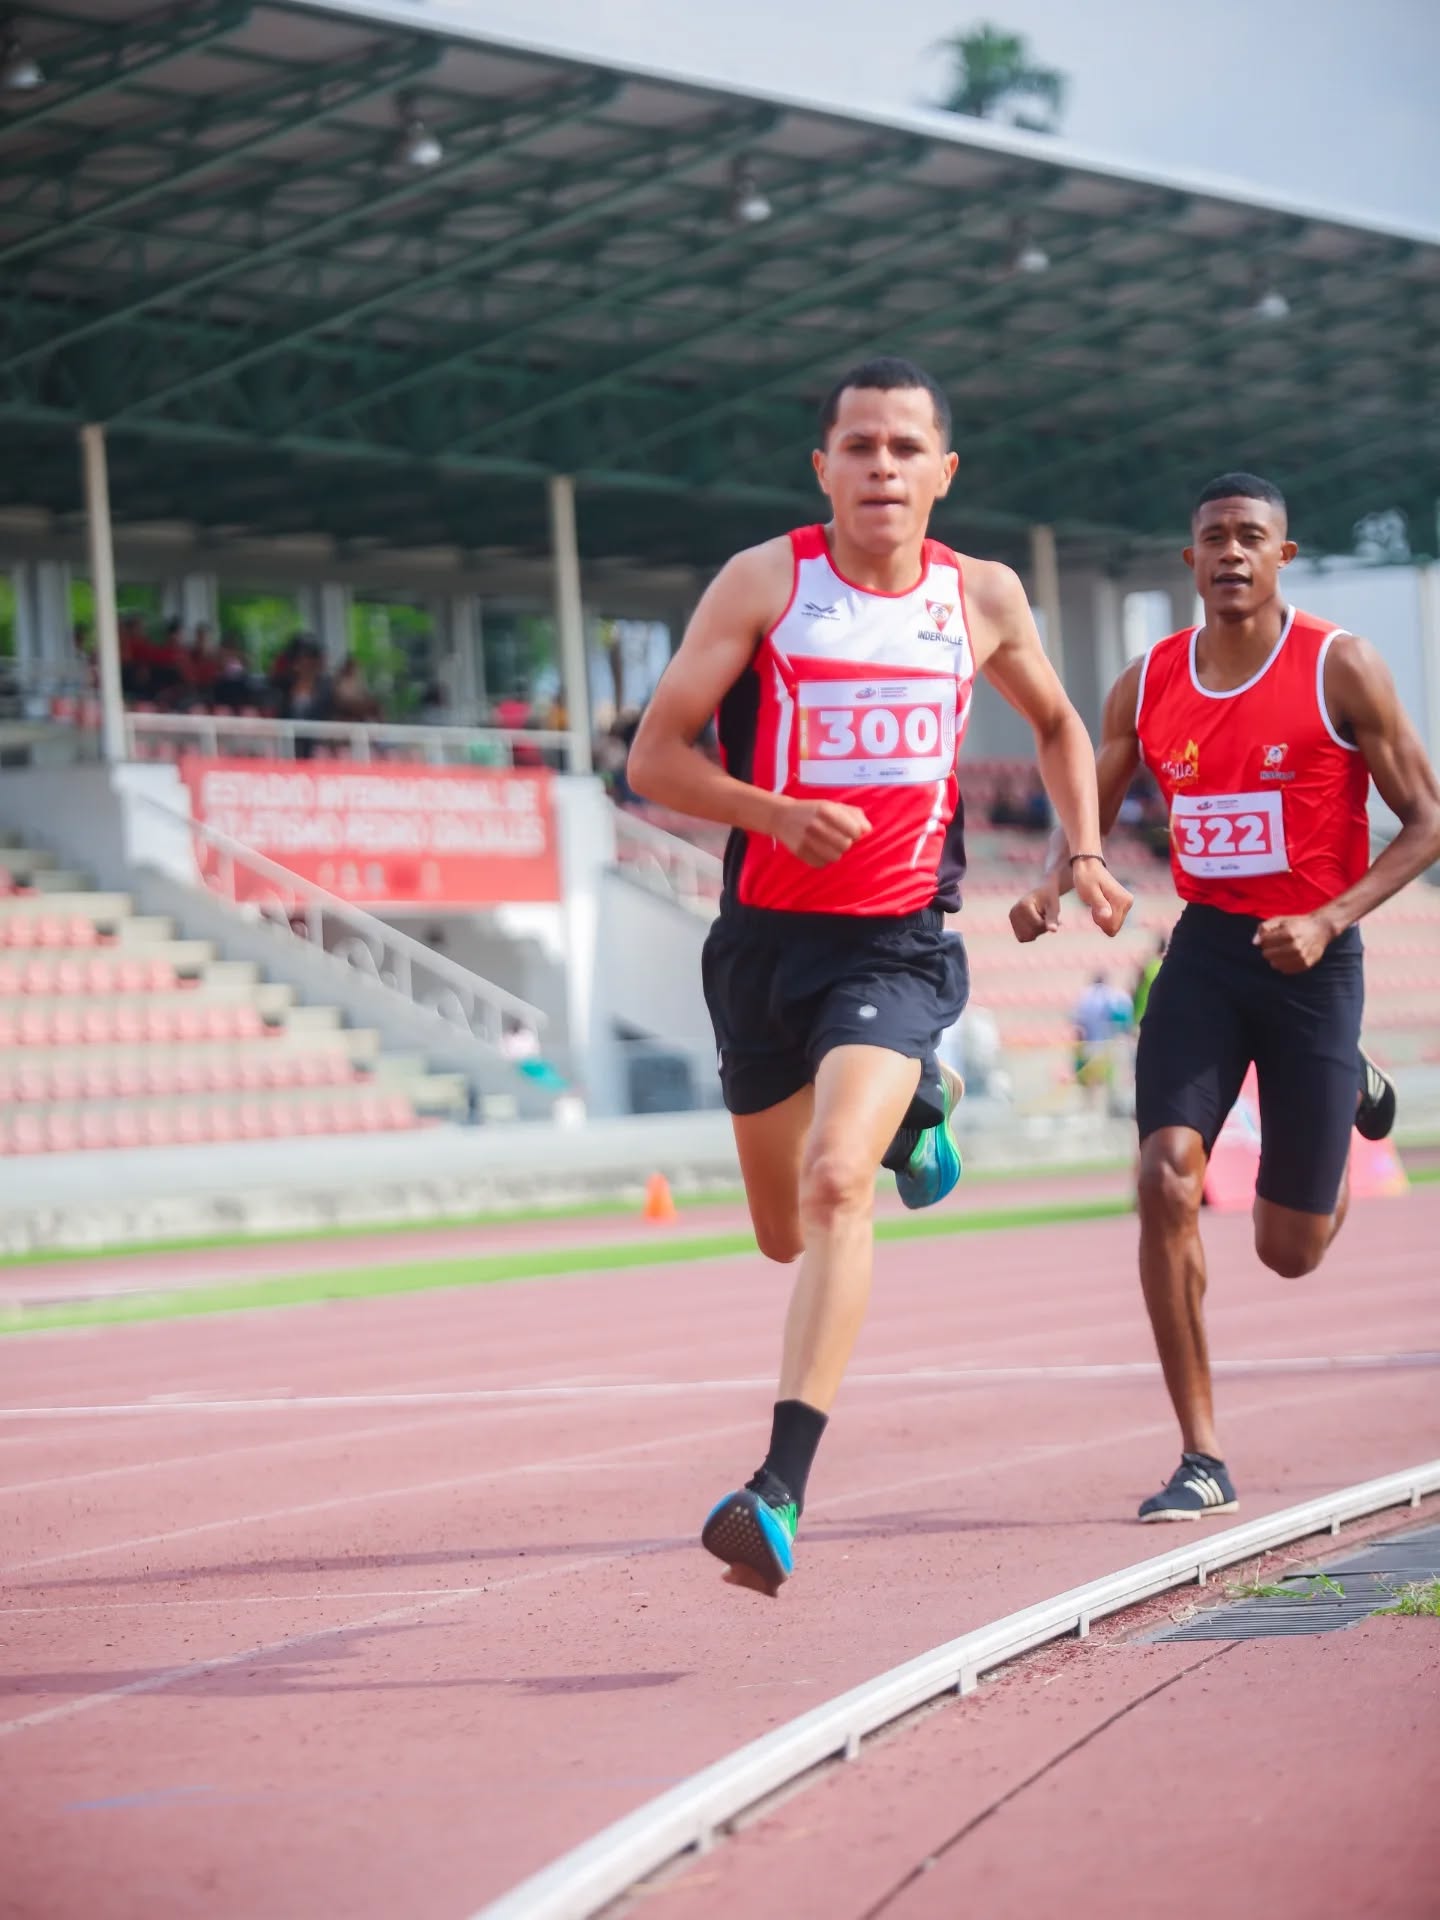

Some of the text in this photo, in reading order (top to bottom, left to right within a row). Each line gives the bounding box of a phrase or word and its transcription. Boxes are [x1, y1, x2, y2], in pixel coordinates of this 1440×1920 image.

[917, 629, 963, 646] INDERVALLE
[819, 707, 938, 756] 300
[1180, 815, 1266, 855] 322
